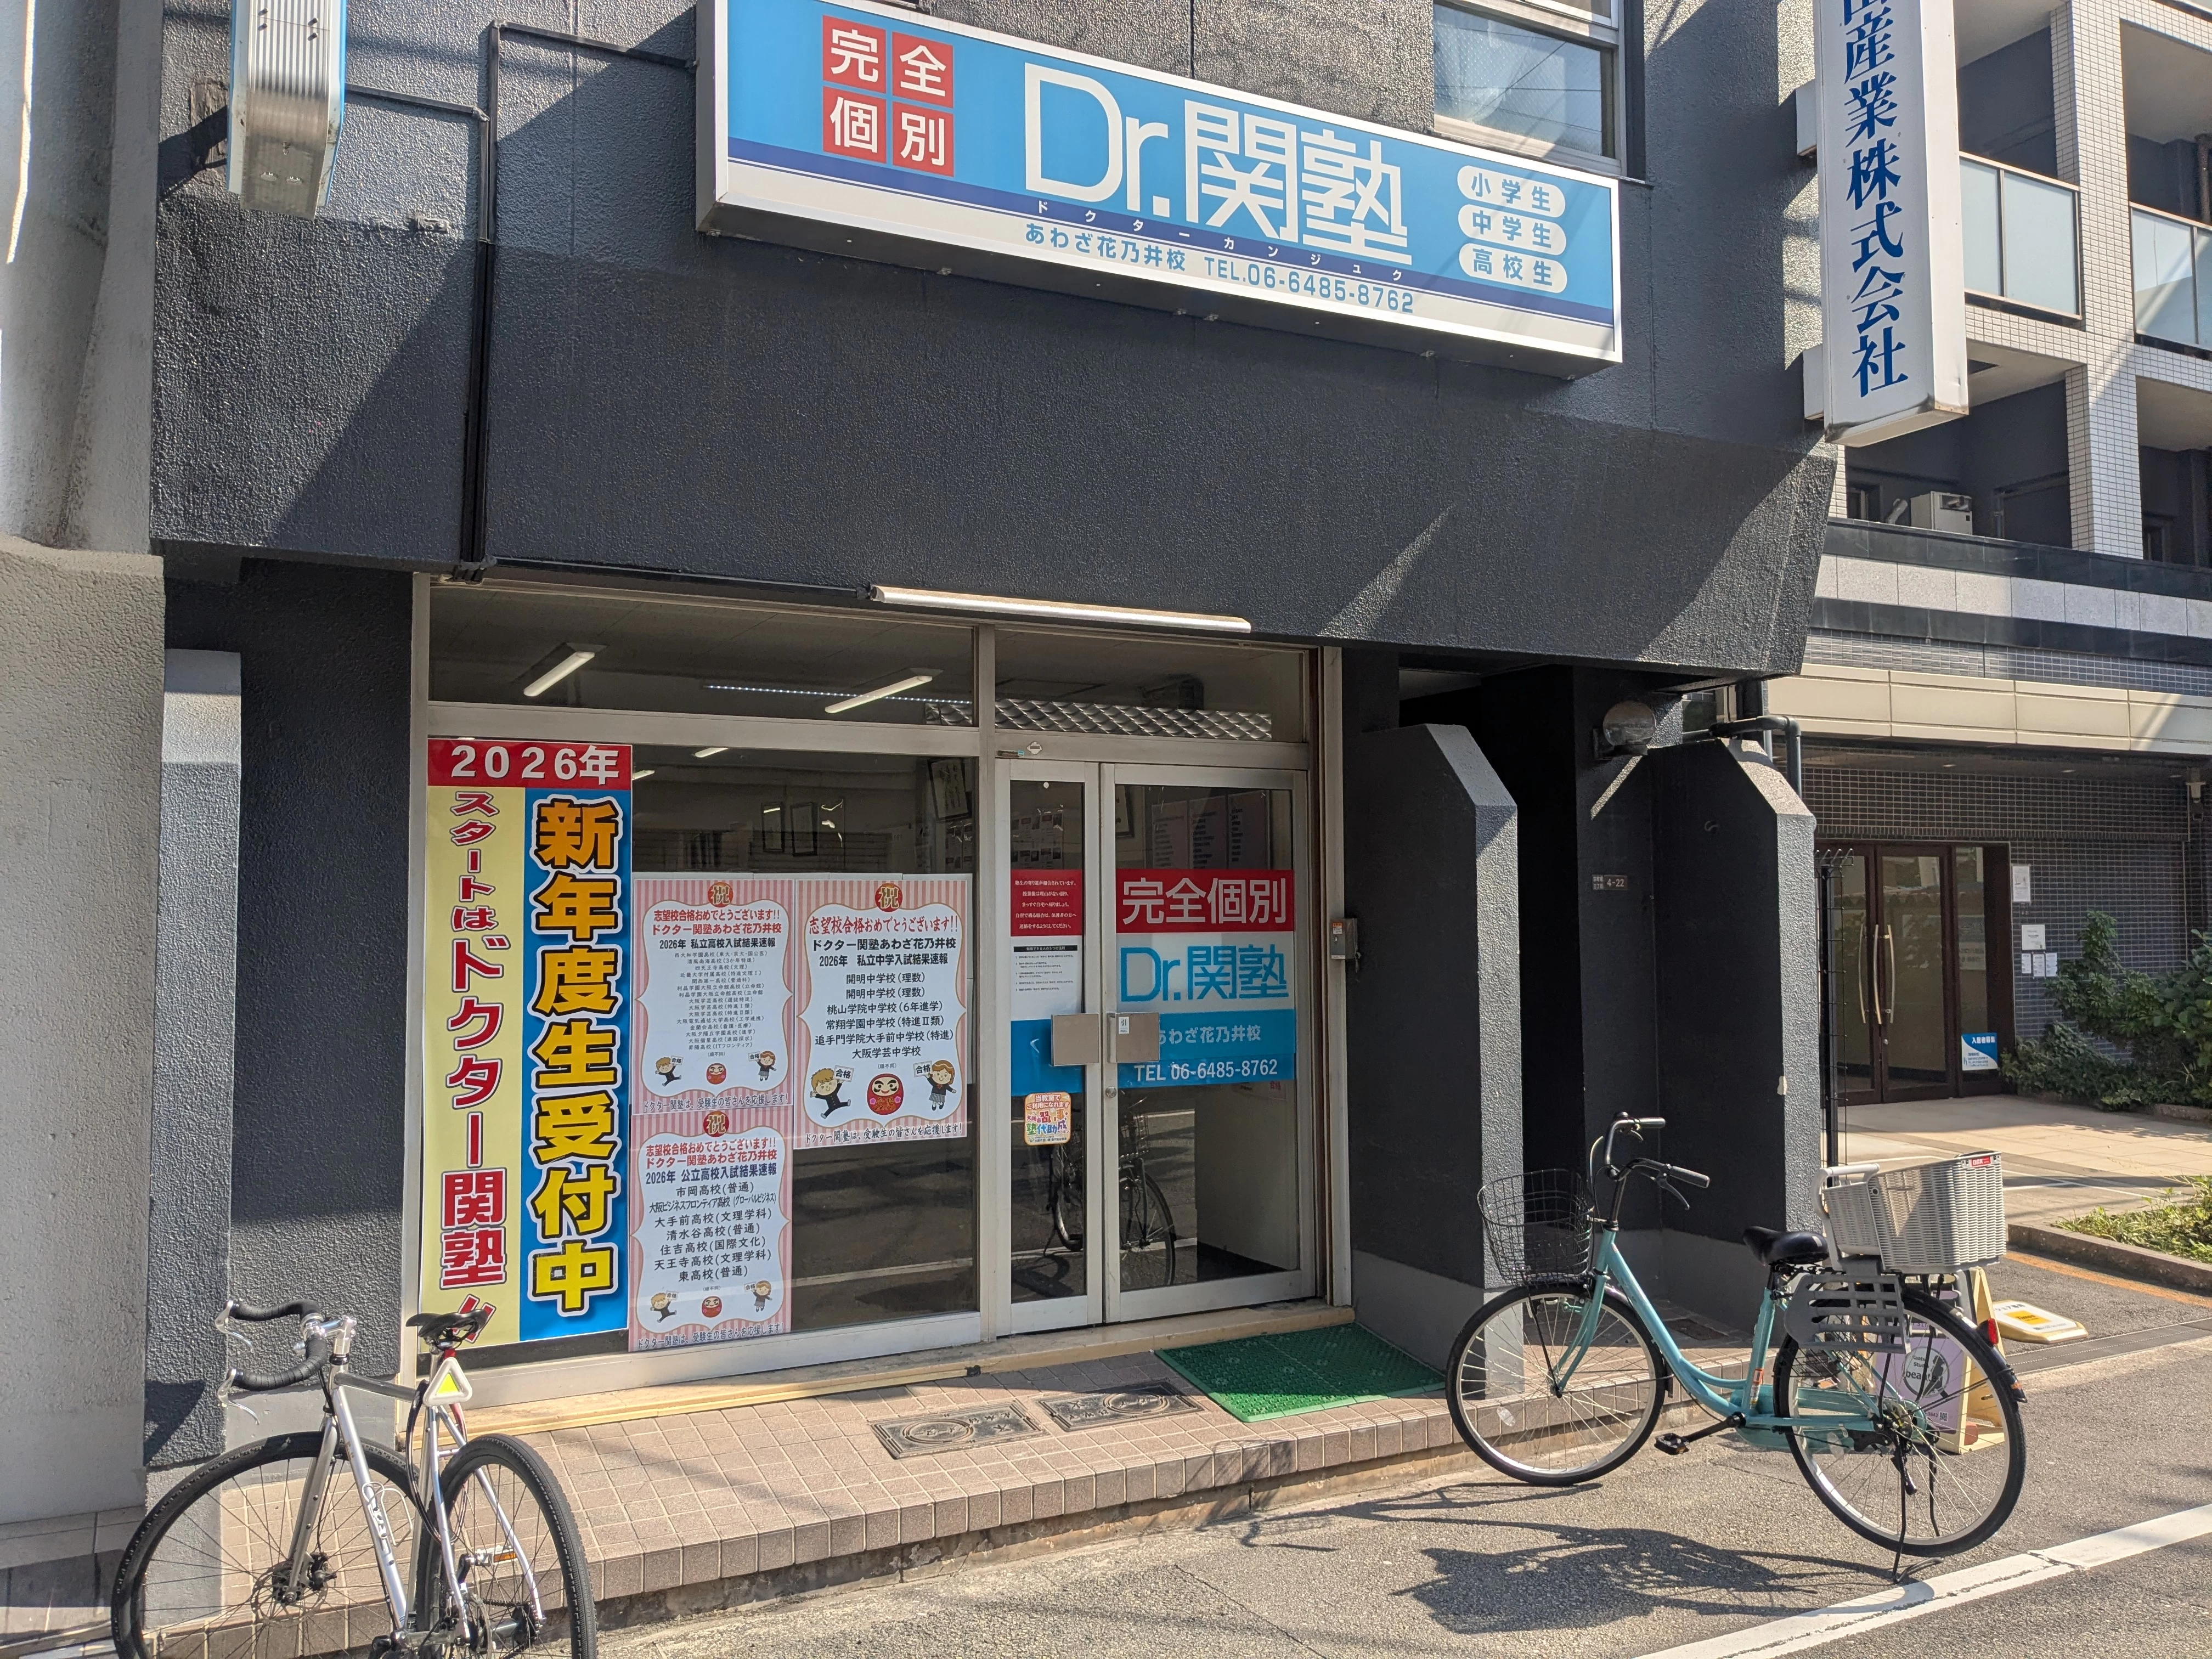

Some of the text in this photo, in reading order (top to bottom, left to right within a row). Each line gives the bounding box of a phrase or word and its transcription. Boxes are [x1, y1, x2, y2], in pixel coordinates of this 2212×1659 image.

[830, 29, 946, 97] 完全
[830, 95, 945, 166] 個別
[1024, 62, 1413, 266] Dr.関塾
[1471, 172, 1551, 212] 小学生
[1472, 210, 1552, 249] 中学生
[1037, 200, 1403, 281] ドクターカンジュク
[1025, 223, 1414, 314] あわざ花乃井校 TEL.06-6485-8762
[1472, 249, 1553, 286] 高校生
[450, 744, 619, 785] 2026年
[1607, 878, 1624, 887] 4-22
[712, 885, 730, 906] 祝
[878, 886, 900, 910] 祝
[1122, 877, 1286, 925] 完全個別
[653, 909, 781, 922] 志望校合格おめでとうございます!!
[809, 915, 958, 935] 志望校合格おめでとうございます!!
[652, 923, 782, 935] ドクター関塾あわざ花乃井校
[659, 937, 776, 950] 2026年 私立高校入試結果速報
[813, 937, 956, 952] ドクター関塾あわざ花乃井校
[819, 952, 948, 967] 2026年 私立中学入試結果速報
[1120, 944, 1289, 1002] Dr.関塾
[528, 795, 621, 1314] 新年度生受付中
[851, 1046, 922, 1059] 大阪学芸中学校
[835, 1069, 851, 1079] 合格
[915, 1064, 932, 1074] 合格
[1133, 1059, 1278, 1082] TEL 06-6485-8762
[1026, 1101, 1070, 1109] ご利用になれます
[1035, 1094, 1061, 1102] 当教室で
[706, 1113, 726, 1135] 祝
[1026, 1119, 1068, 1136] 塾代助成
[646, 1137, 776, 1157] 志望校合格おめでとうございます!!
[646, 1149, 777, 1169] ドクター関塾あわざ花乃井校
[646, 1162, 777, 1184] 2026年 公立高校入試結果速報
[676, 1181, 754, 1198] 市岡高校(普通)
[654, 1207, 772, 1228] 大手前高校(文理学科)
[666, 1222, 760, 1241] 清水谷高校(普通)
[654, 1249, 771, 1271] 天王寺高校(文理学科)
[678, 1265, 748, 1282] 東高校(普通)
